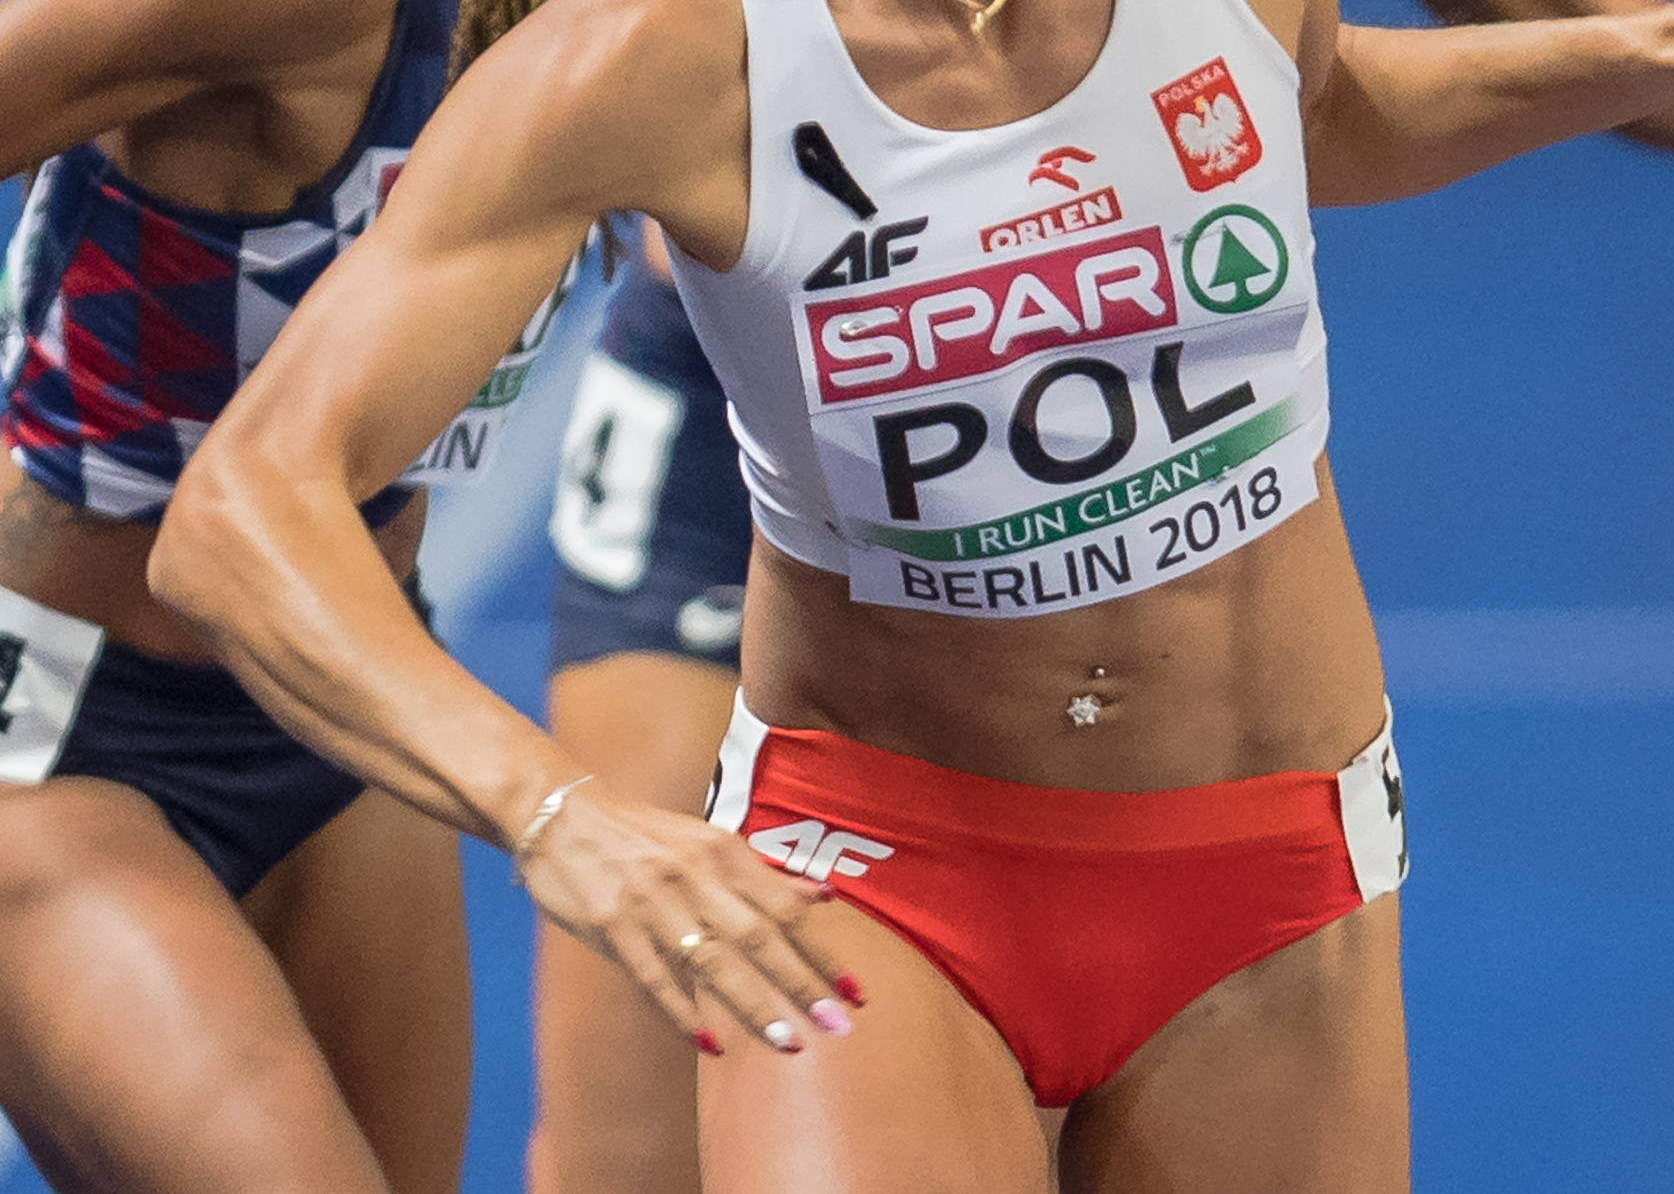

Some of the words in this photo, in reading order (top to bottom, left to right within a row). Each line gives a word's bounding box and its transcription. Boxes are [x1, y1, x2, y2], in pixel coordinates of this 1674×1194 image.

[988, 195, 1115, 249] ORLEN
[820, 247, 1166, 387] SPAR
[872, 341, 1257, 522] POL
[899, 541, 1133, 610] BERLIN
[1148, 466, 1283, 571] 2018
[954, 532, 964, 557] I
[977, 513, 1069, 553] RUN
